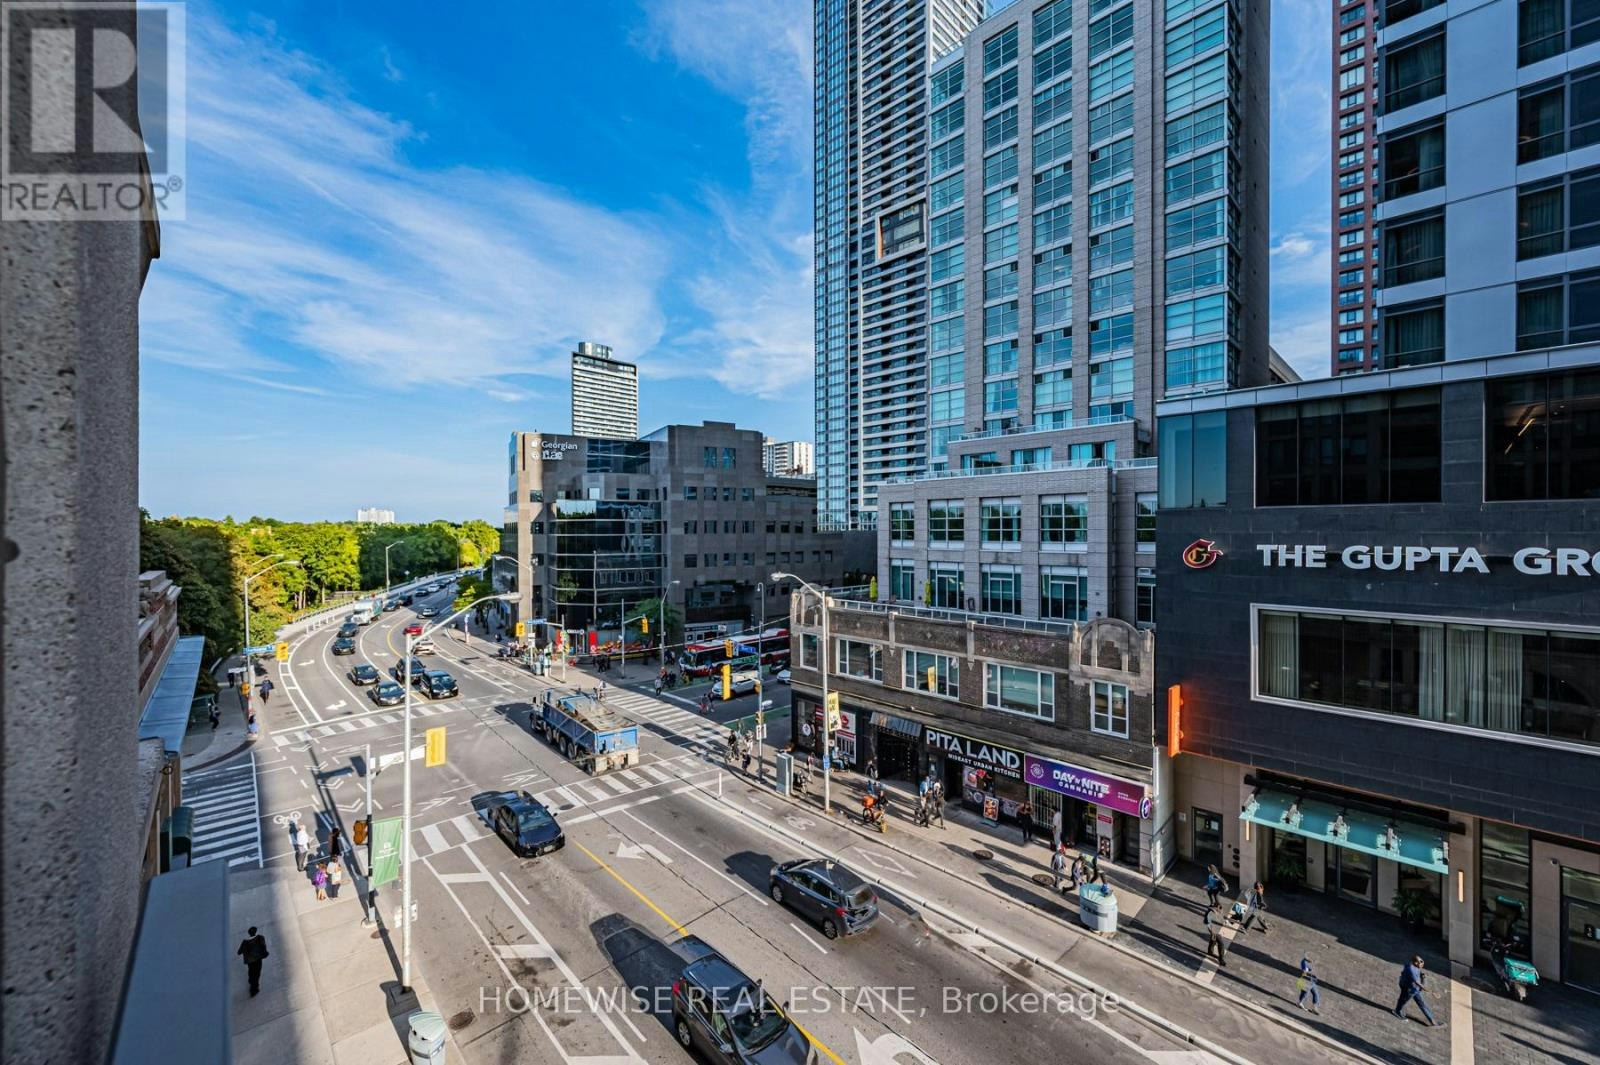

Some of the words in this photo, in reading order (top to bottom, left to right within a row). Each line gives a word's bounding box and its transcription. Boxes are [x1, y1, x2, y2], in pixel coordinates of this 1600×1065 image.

[541, 441, 578, 451] Georgian
[1257, 544, 1327, 568] THE
[1342, 545, 1490, 574] GUPTA
[1513, 547, 1600, 576] GR
[926, 729, 964, 755] PITA
[966, 740, 1021, 769] LAND
[947, 753, 972, 765] MIDEAST
[973, 760, 993, 771] URBAN
[994, 766, 1021, 778] KITCHEN
[1053, 770, 1076, 783] DAY
[1081, 777, 1110, 794] NITE
[1058, 781, 1103, 798] CANNABIS
